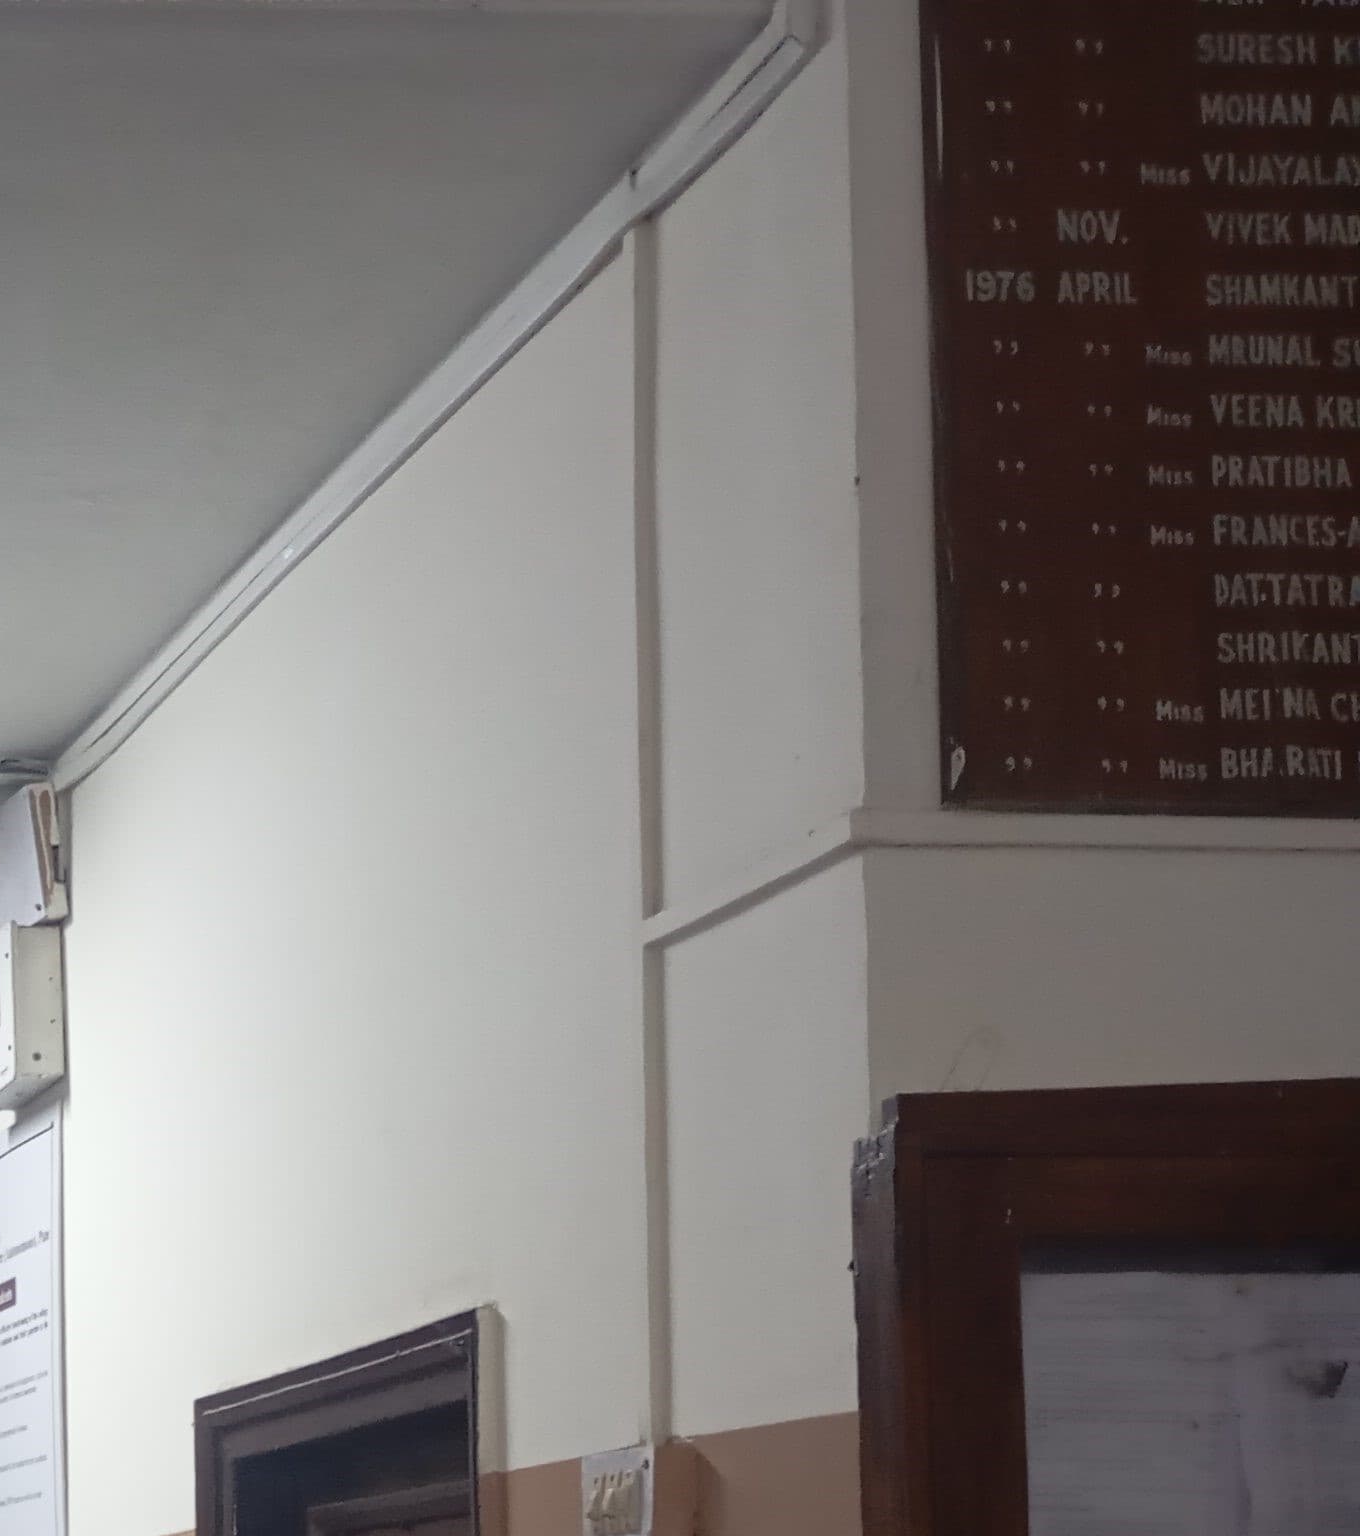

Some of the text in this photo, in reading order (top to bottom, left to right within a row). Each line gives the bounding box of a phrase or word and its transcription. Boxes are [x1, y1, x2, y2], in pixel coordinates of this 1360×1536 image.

[1197, 33, 1359, 64] SURESH K
[1200, 94, 1312, 126] MOHAN
[1057, 209, 1128, 245] NOV.
[1205, 212, 1293, 246] VIVEK
[966, 270, 1035, 301] 1976
[1057, 271, 1137, 304] APRIL
[1209, 335, 1321, 367] MRUNAL
[1211, 394, 1304, 427] VEENA
[1316, 395, 1359, 428] KR
[1211, 455, 1353, 488] PRATIBHA
